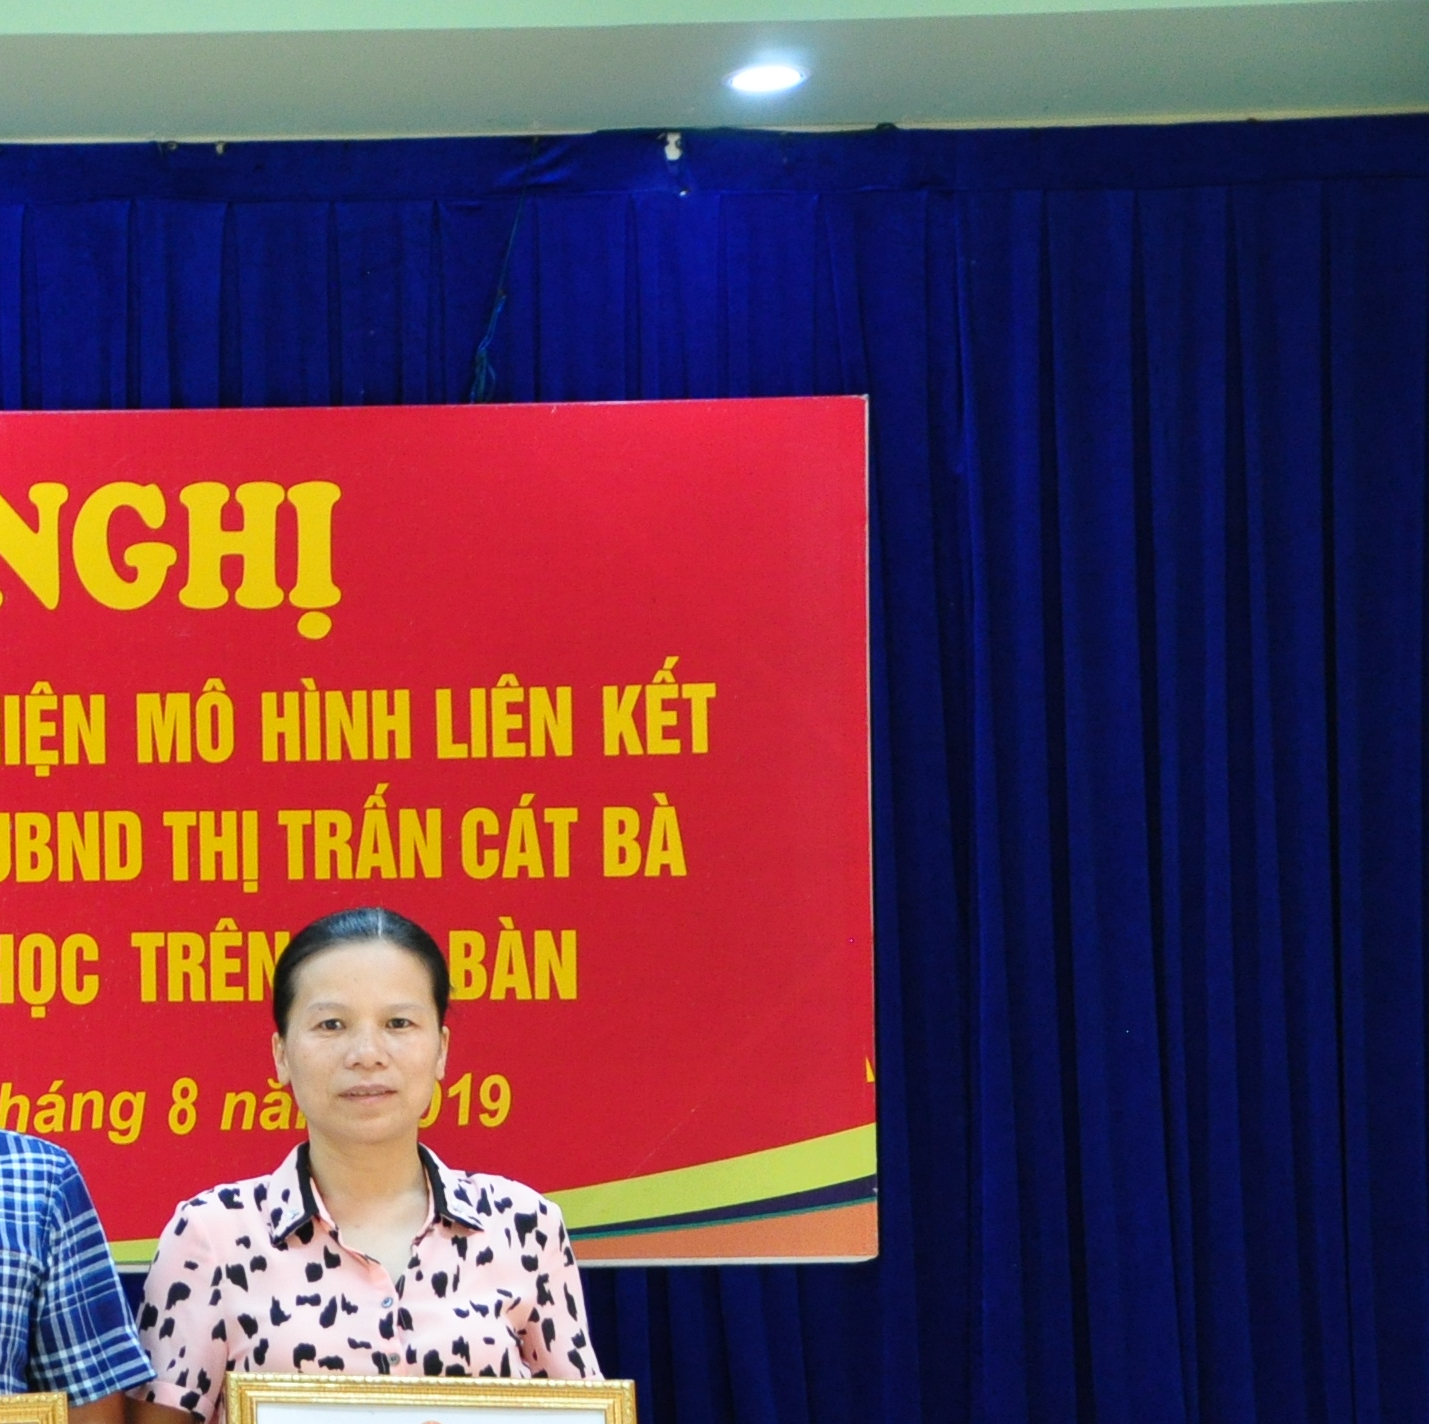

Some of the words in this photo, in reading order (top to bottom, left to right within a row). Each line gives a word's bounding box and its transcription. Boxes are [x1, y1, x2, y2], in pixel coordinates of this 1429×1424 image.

[136, 677, 235, 764] MÔ
[261, 677, 412, 762] HÌNH
[435, 673, 573, 759] LIÊN
[602, 656, 717, 756] KẾT
[162, 810, 259, 893] THỊ
[277, 783, 442, 880] TRẤN
[461, 793, 579, 880] CÁT
[603, 792, 687, 877] BÀ
[130, 917, 290, 1003] TRÊN
[448, 916, 577, 1001] BÀN
[168, 1077, 198, 1135] 8
